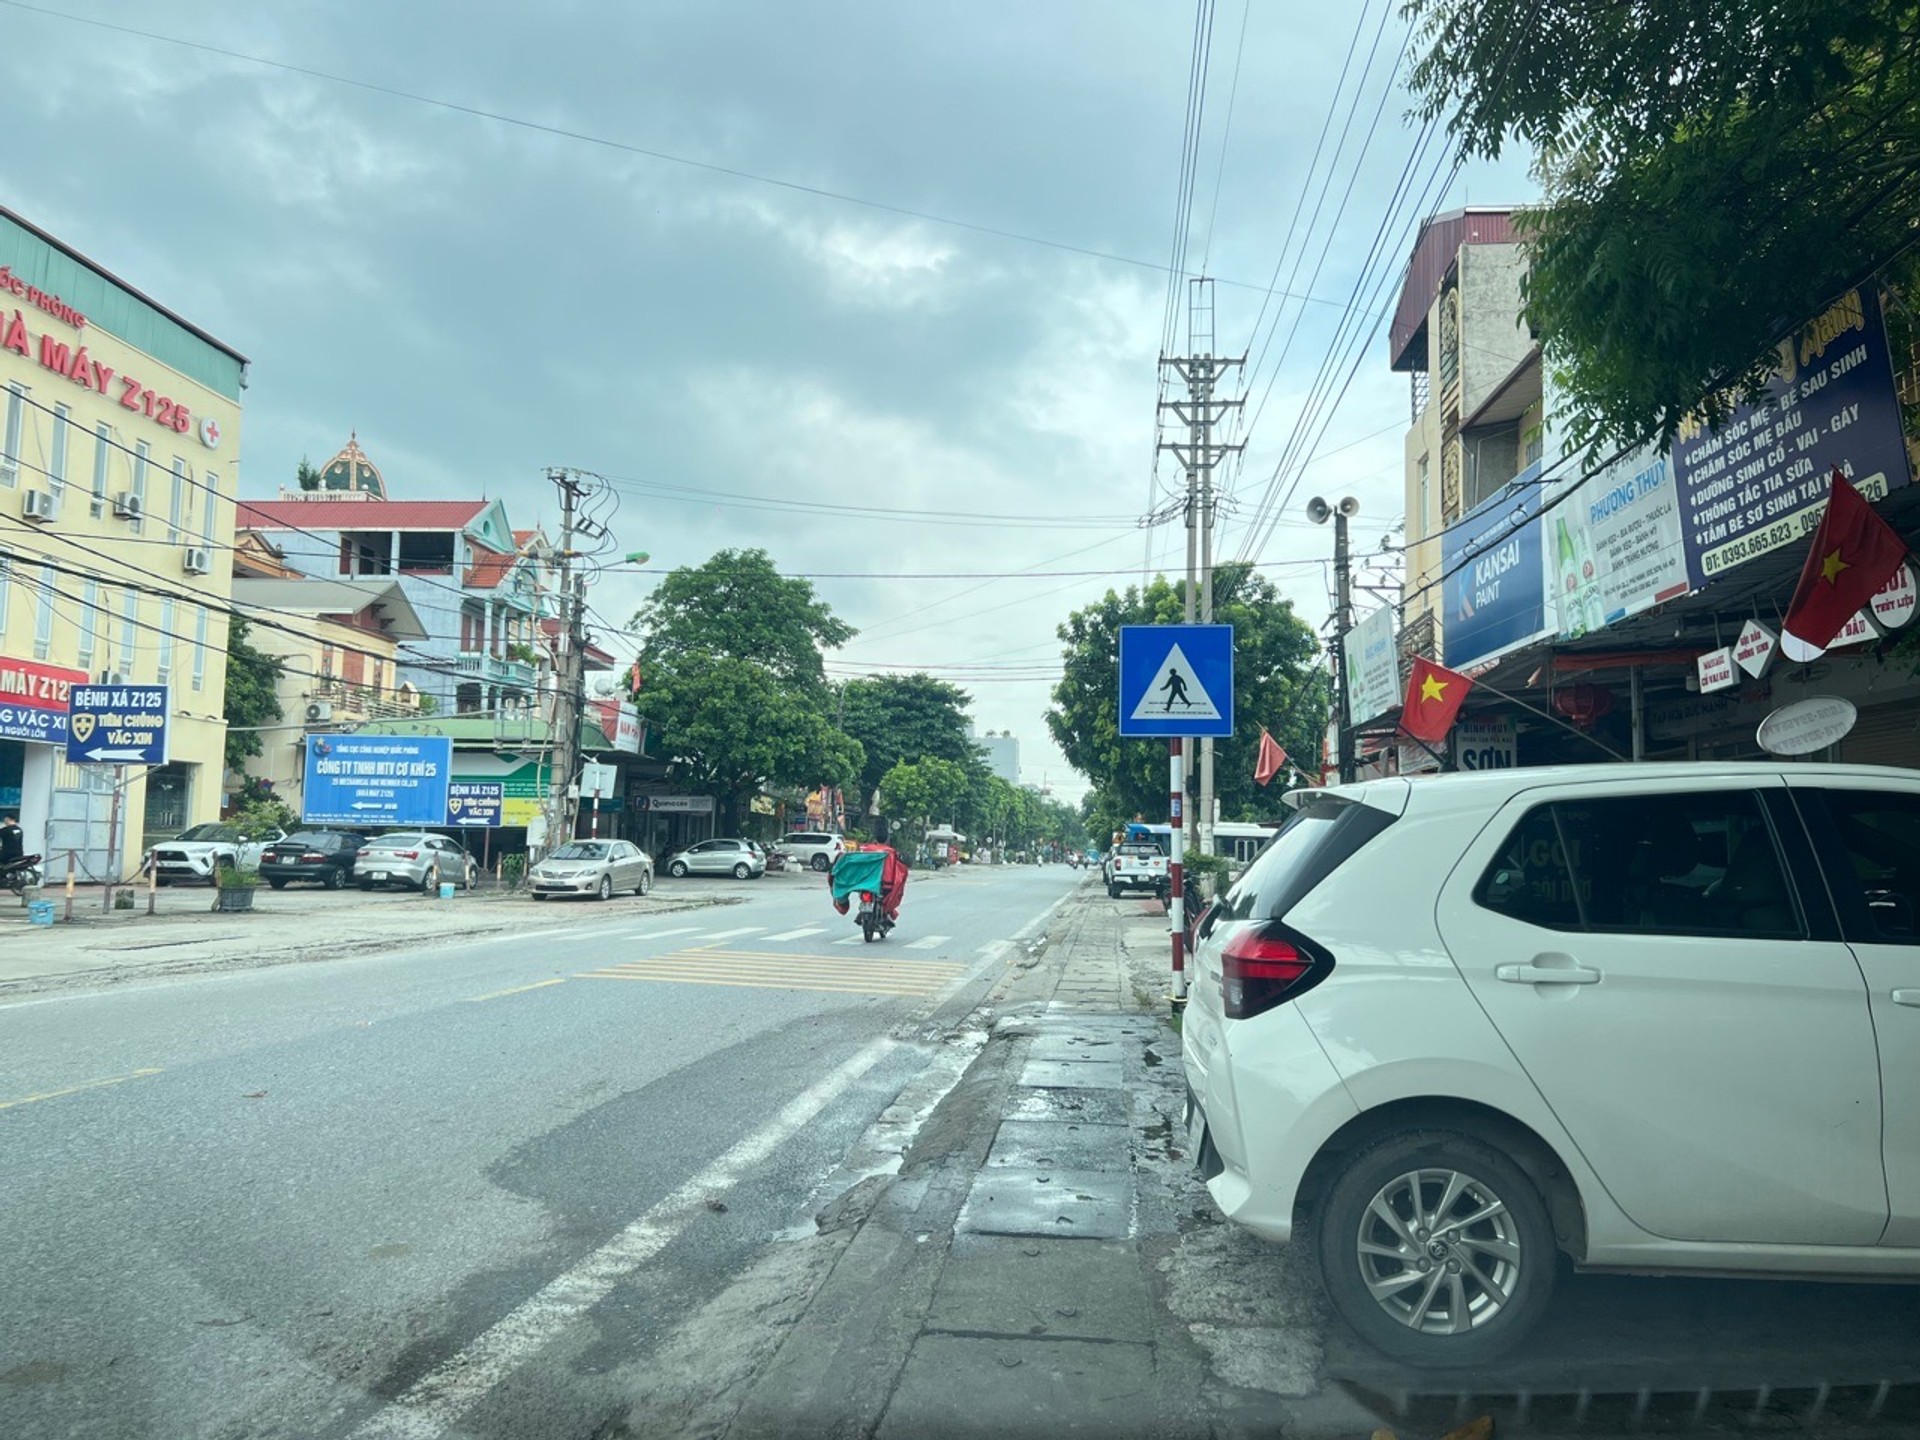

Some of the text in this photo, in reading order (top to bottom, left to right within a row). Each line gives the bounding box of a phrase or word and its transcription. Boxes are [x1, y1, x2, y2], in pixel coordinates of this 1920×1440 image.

[27, 285, 86, 329] PHÒNG
[40, 334, 114, 395] MÁY
[120, 376, 190, 434] Z125
[1691, 434, 1723, 467] CHĂM
[1725, 423, 1748, 447] SÓC
[1750, 408, 1769, 430] MẸ
[1781, 390, 1798, 411] BÉ
[1800, 375, 1828, 398] SAU
[1831, 344, 1868, 380] SINH
[1693, 411, 1803, 485] CHĂM SÓC MẸ BẦU
[1696, 472, 1734, 506] DƯỠNG
[1736, 461, 1765, 486] SINH
[1769, 440, 1785, 468] CỔ
[1796, 428, 1819, 453] VAI
[1830, 403, 1859, 434] GÁY
[1590, 481, 1635, 525] PHƯƠNG
[1699, 457, 1814, 525] THÔNG TẮC TIA SỮA
[1729, 513, 1744, 533] BÉ
[1747, 505, 1764, 524] SƠ
[1766, 489, 1797, 516] SINH
[1799, 475, 1822, 501] TẠI
[1823, 459, 1854, 491] NÀ
[1475, 539, 1520, 587] KANSAI
[1705, 552, 1721, 572] ĐT:
[1722, 521, 1791, 565] 0393.665.623
[1475, 581, 1501, 609] PAINT
[1, 667, 71, 704] MÁY Z12
[75, 688, 162, 711] BỆNH XÁ Z125
[17, 709, 49, 728] VẮC
[52, 716, 67, 731] XI
[98, 711, 122, 727] TIÊM
[107, 729, 153, 746] VẮC XIN
[317, 757, 437, 777] CÔNG TY TNHH MTV CƠ KHÍ 25
[450, 784, 470, 797] BỆNH
[470, 784, 480, 795] XÁ
[481, 785, 499, 795] Z125
